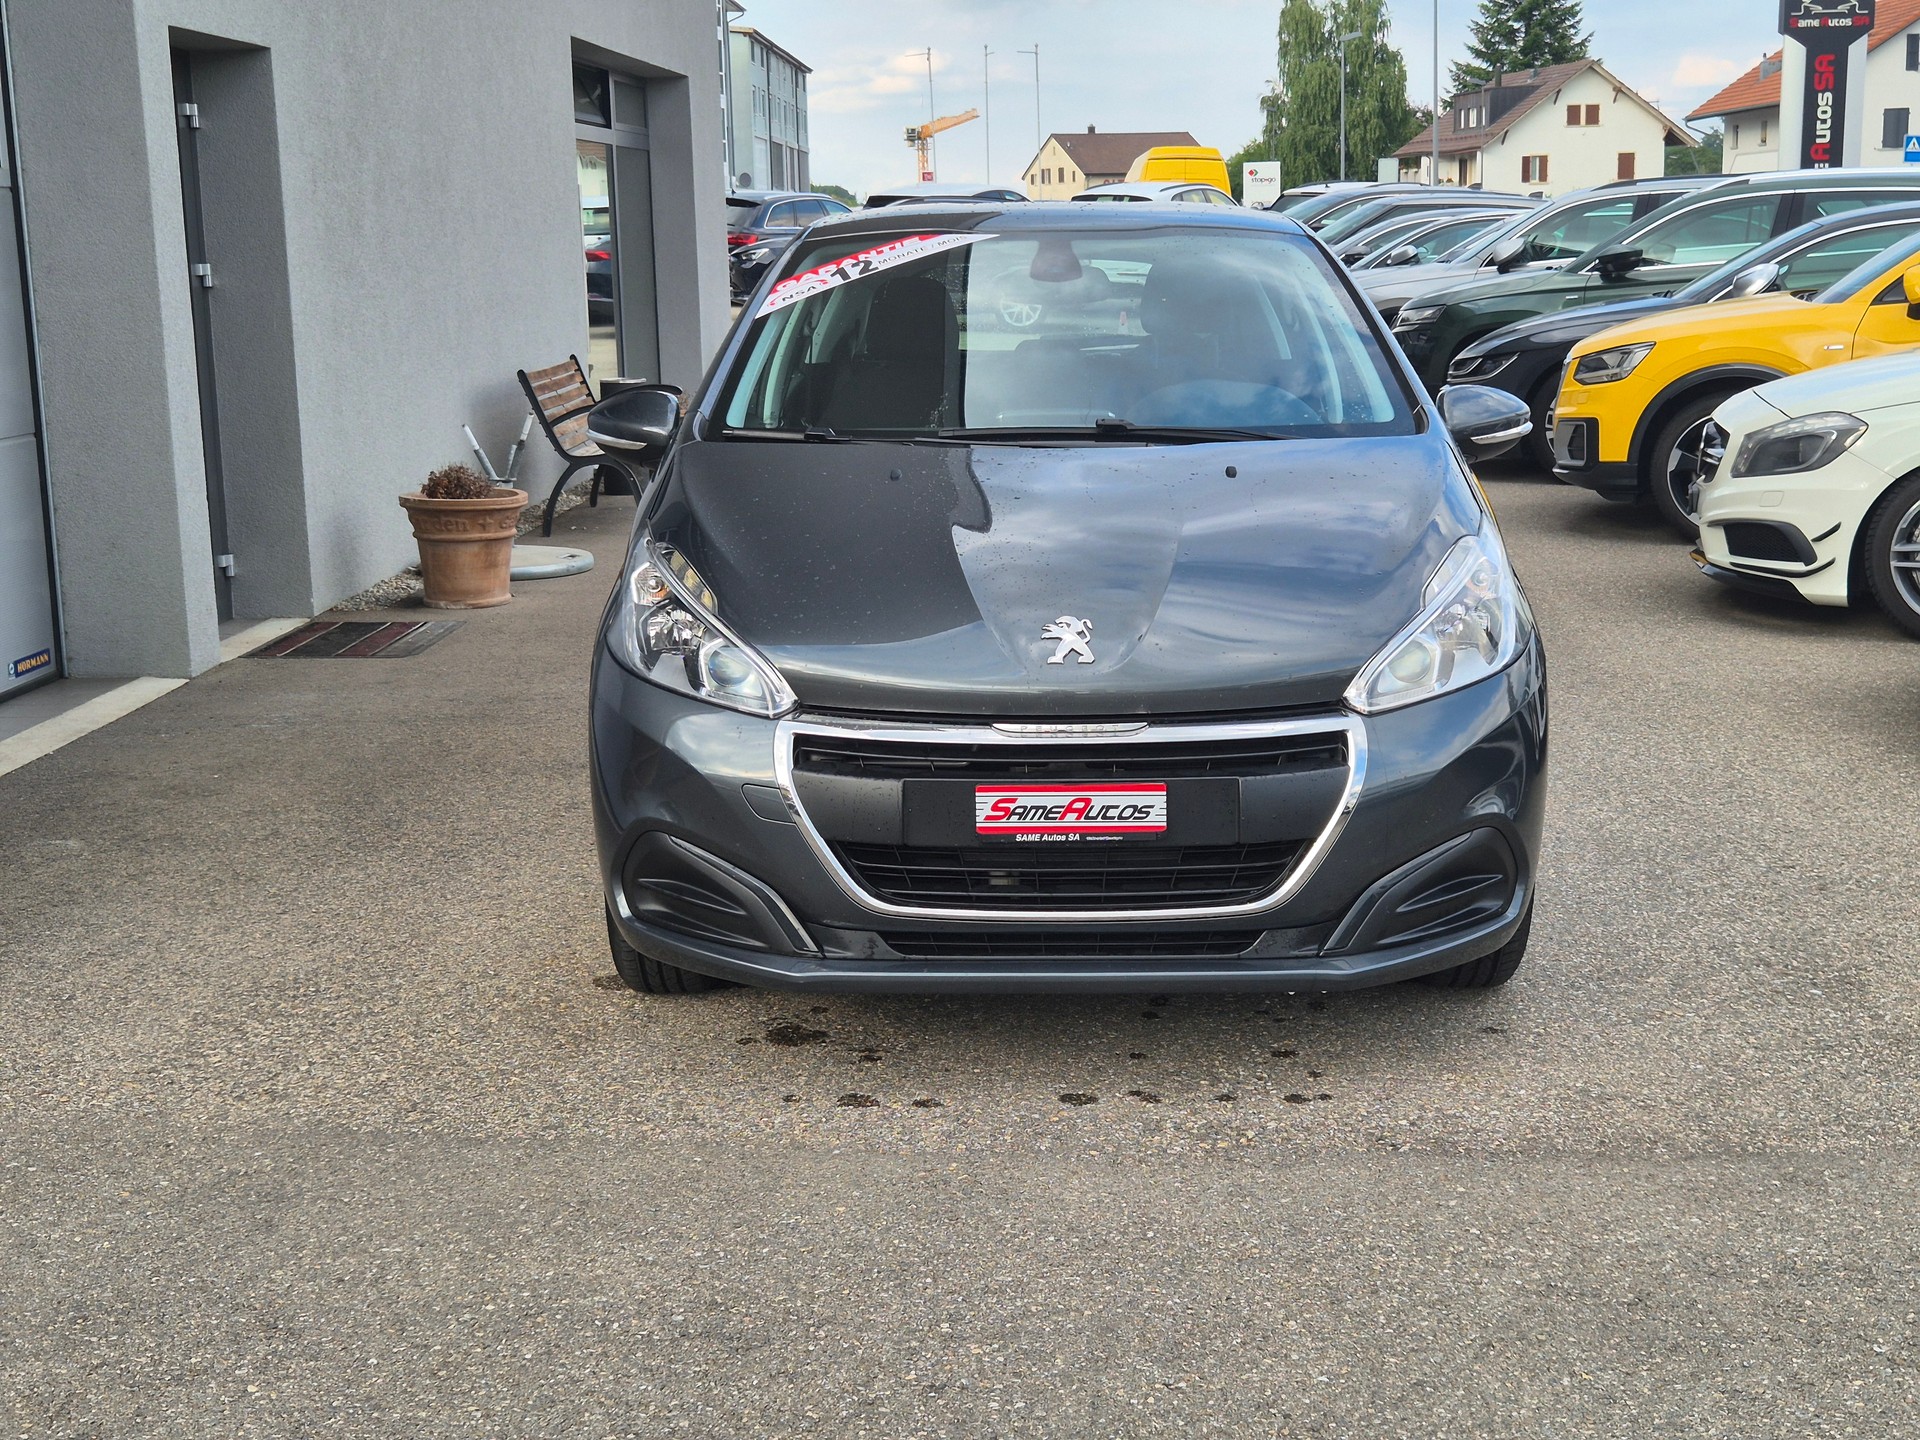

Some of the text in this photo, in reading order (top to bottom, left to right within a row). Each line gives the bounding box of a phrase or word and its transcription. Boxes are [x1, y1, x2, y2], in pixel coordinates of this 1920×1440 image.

[830, 260, 879, 282] 12
[1015, 833, 1042, 842] SAME
[1042, 833, 1066, 842] Autos
[1067, 833, 1080, 841] SA
